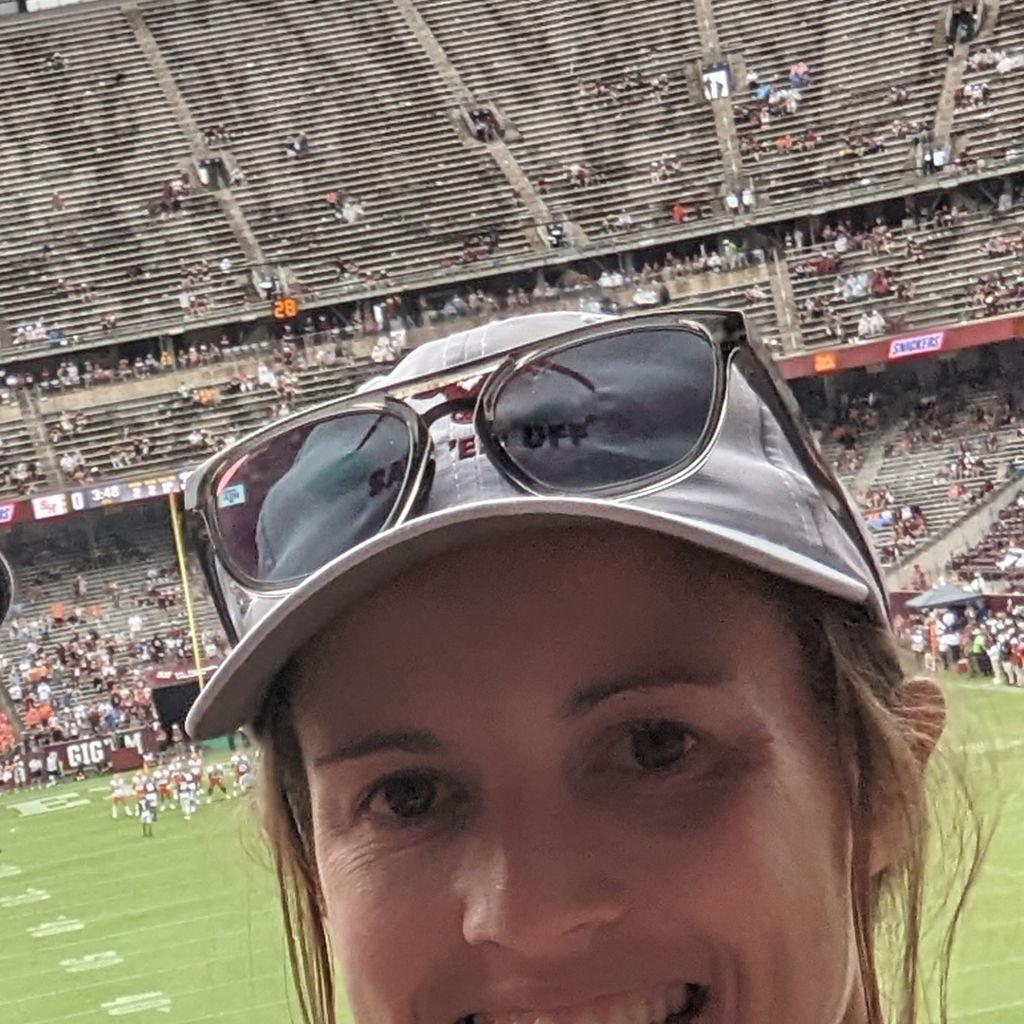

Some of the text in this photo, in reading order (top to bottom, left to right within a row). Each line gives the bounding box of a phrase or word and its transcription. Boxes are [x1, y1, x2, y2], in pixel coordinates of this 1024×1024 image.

[274, 298, 297, 318] 28
[892, 335, 940, 355] SNICKERS
[66, 739, 105, 768] GIG
